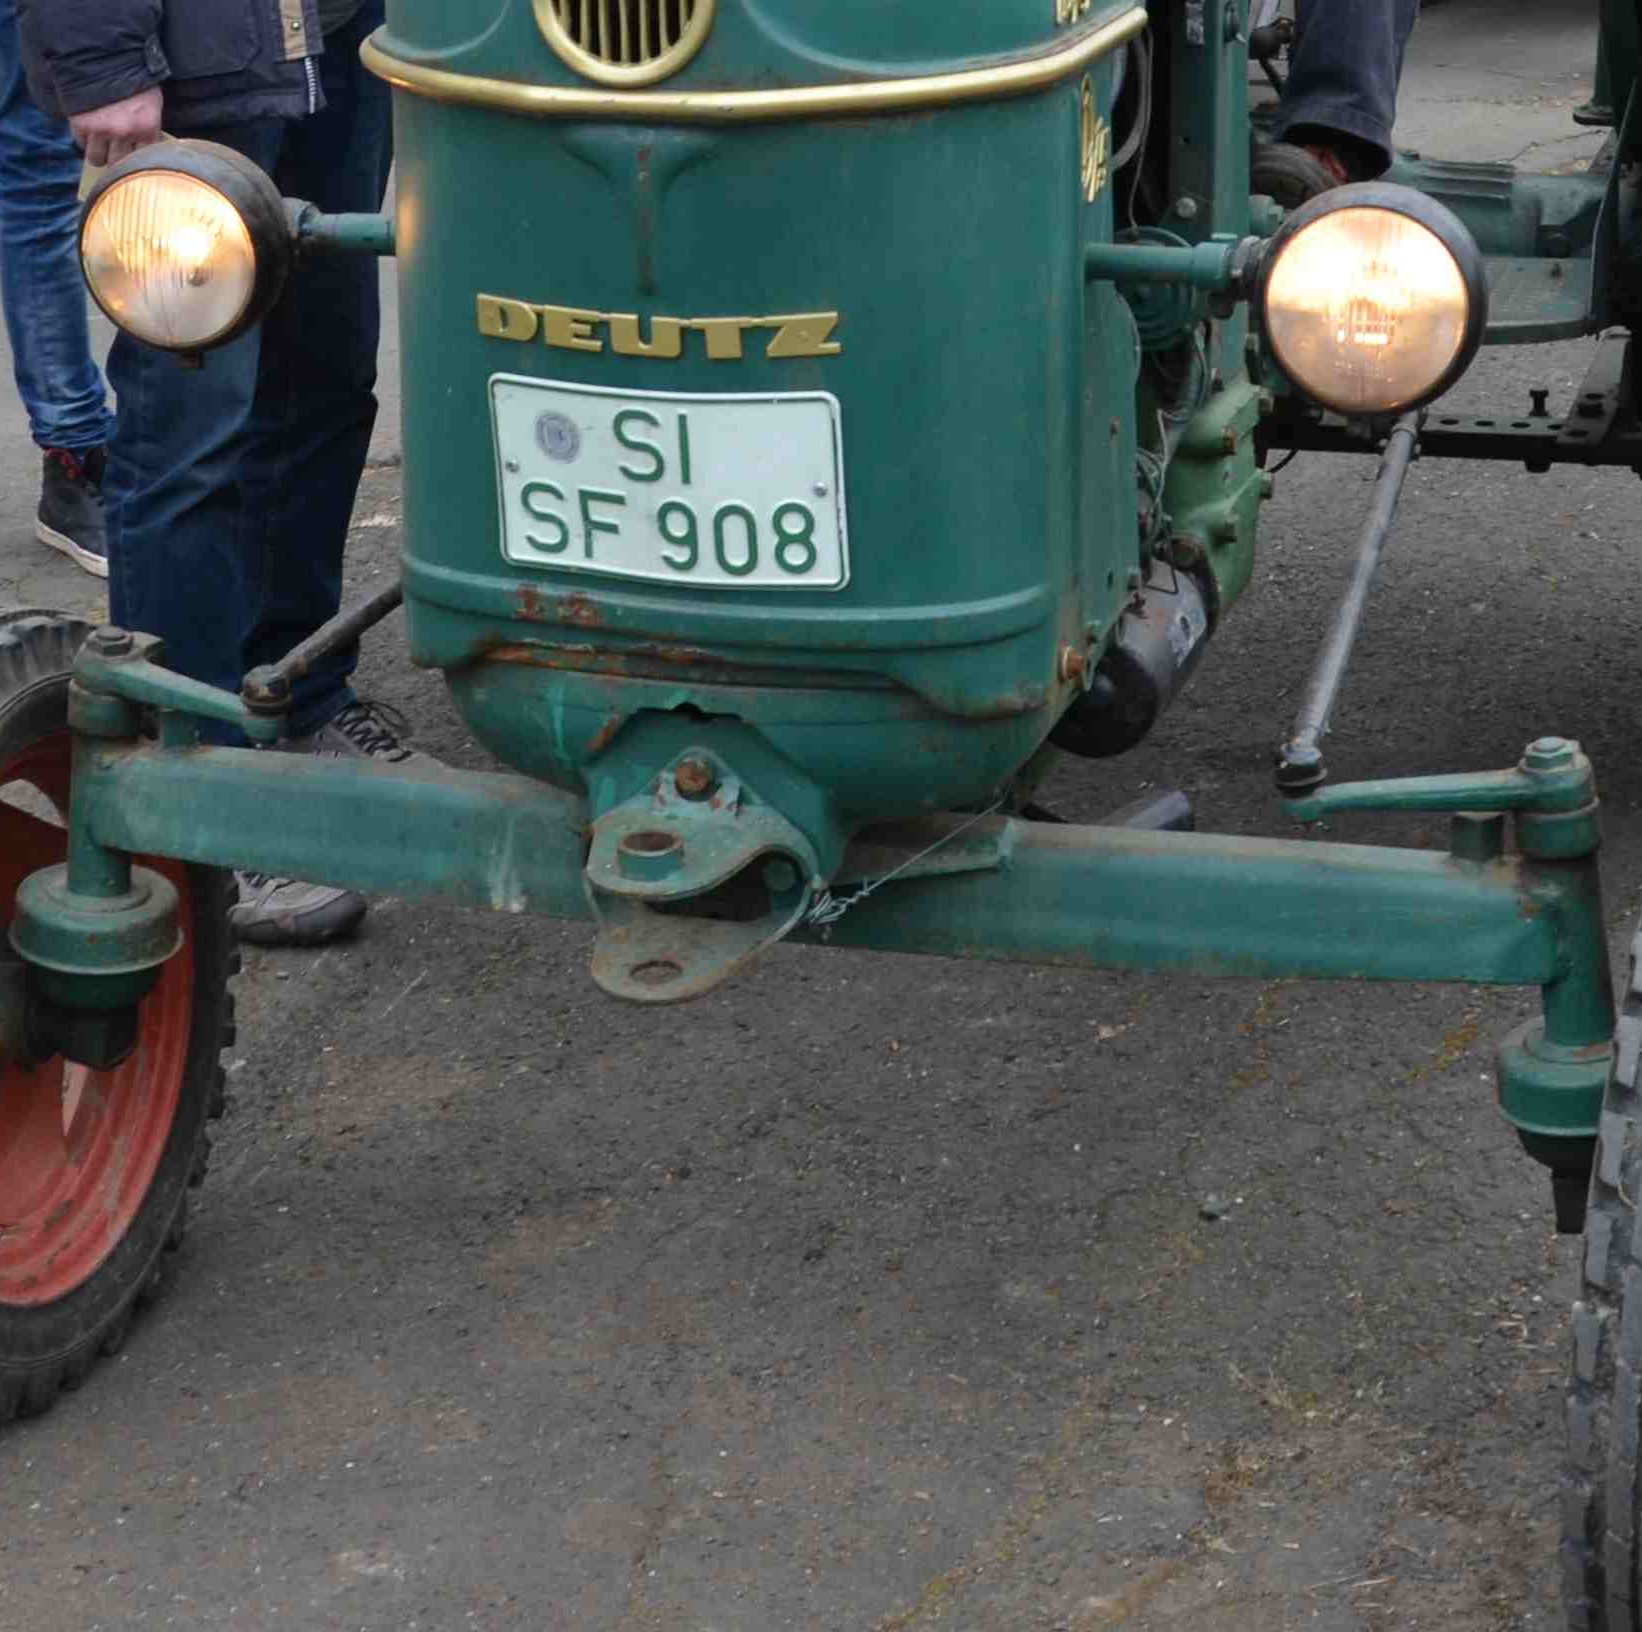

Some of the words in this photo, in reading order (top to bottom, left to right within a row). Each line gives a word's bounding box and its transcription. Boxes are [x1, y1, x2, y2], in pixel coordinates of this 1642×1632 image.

[476, 292, 845, 360] DEUTZ
[612, 408, 692, 486] SI
[520, 479, 628, 560] SF
[657, 500, 819, 577] 908
